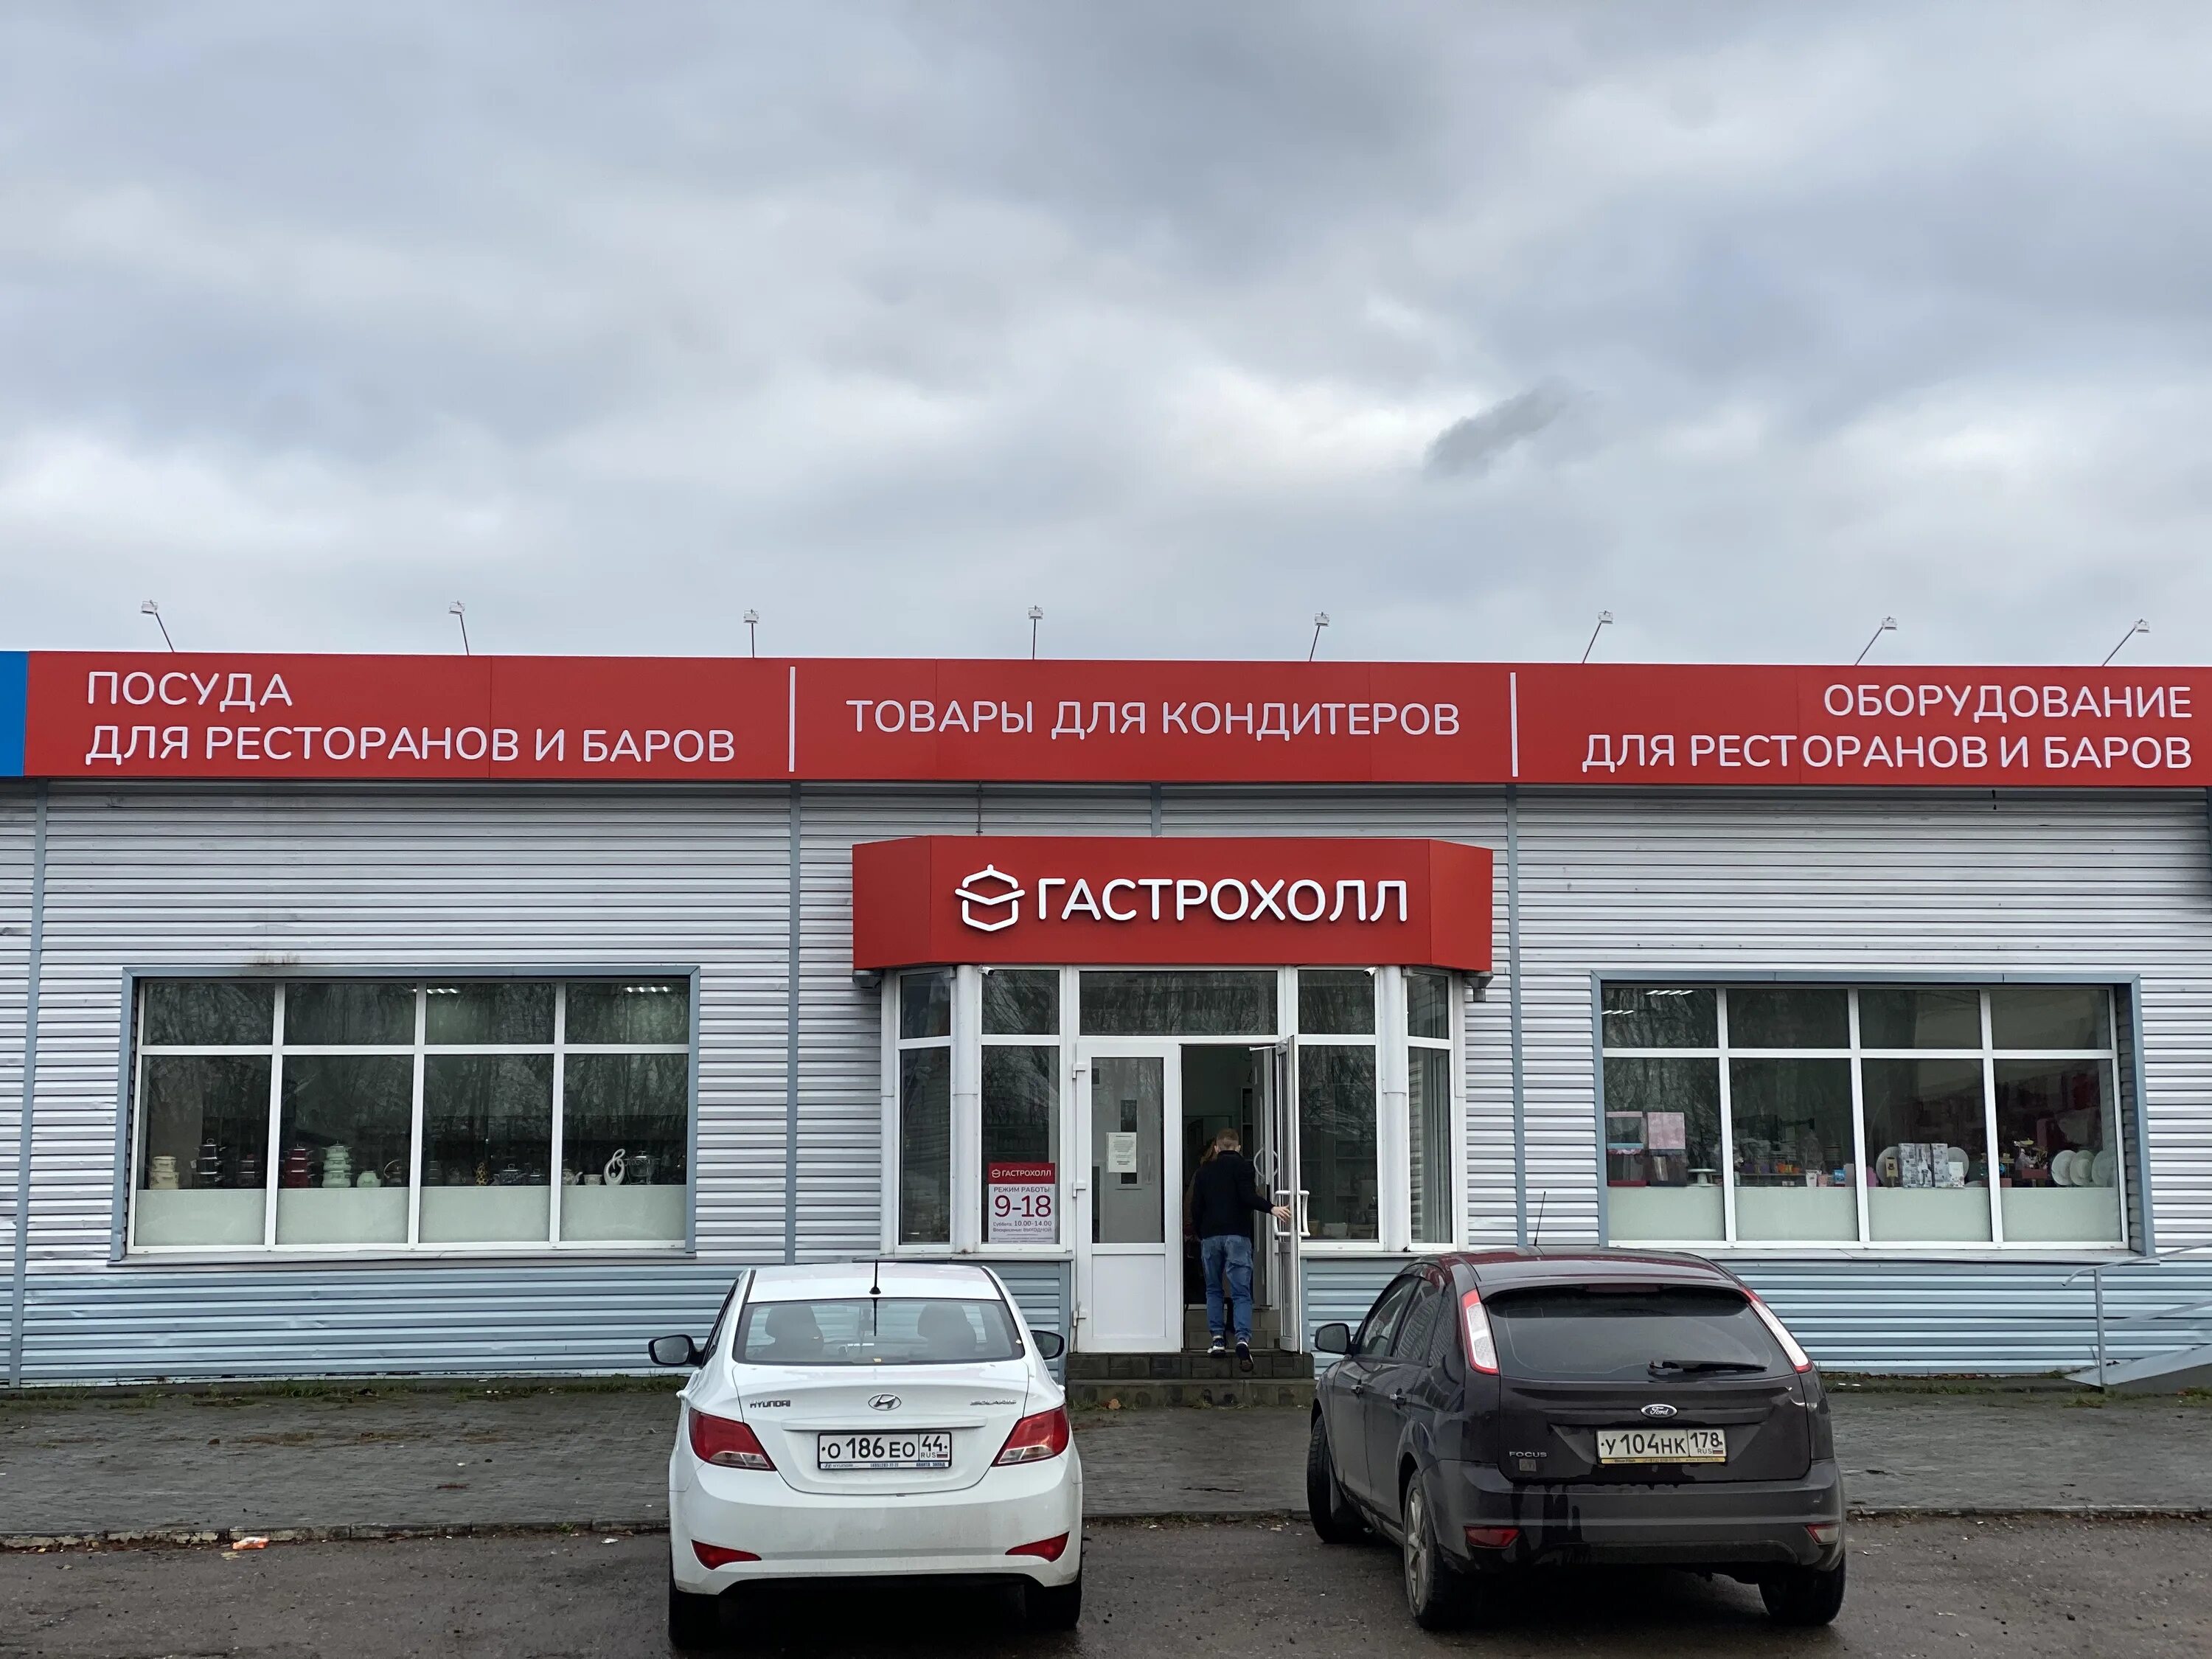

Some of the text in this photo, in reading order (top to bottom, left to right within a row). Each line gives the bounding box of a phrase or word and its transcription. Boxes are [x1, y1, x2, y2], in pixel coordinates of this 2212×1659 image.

[88, 672, 293, 713] ПОСУДА
[1824, 684, 2192, 724] ОБОРУДОВАНИЕ
[846, 700, 1460, 742] ТОВАРЫ ДЛЯ КОНДИТЕРОВ
[85, 725, 734, 766] ДЛЯ РЕСТОРАНОВ И БАРОВ
[1582, 734, 2192, 773] ДЛЯ РЕСТОРАНОВ И БАРОВ
[1038, 877, 1408, 922] ГАСТРОХОЛЛ
[995, 1194, 1051, 1217] 9-18
[749, 1399, 791, 1408] HYUNDAI
[1649, 1406, 1669, 1415] Ford
[921, 1435, 943, 1452] 44
[1689, 1431, 1719, 1449] 178
